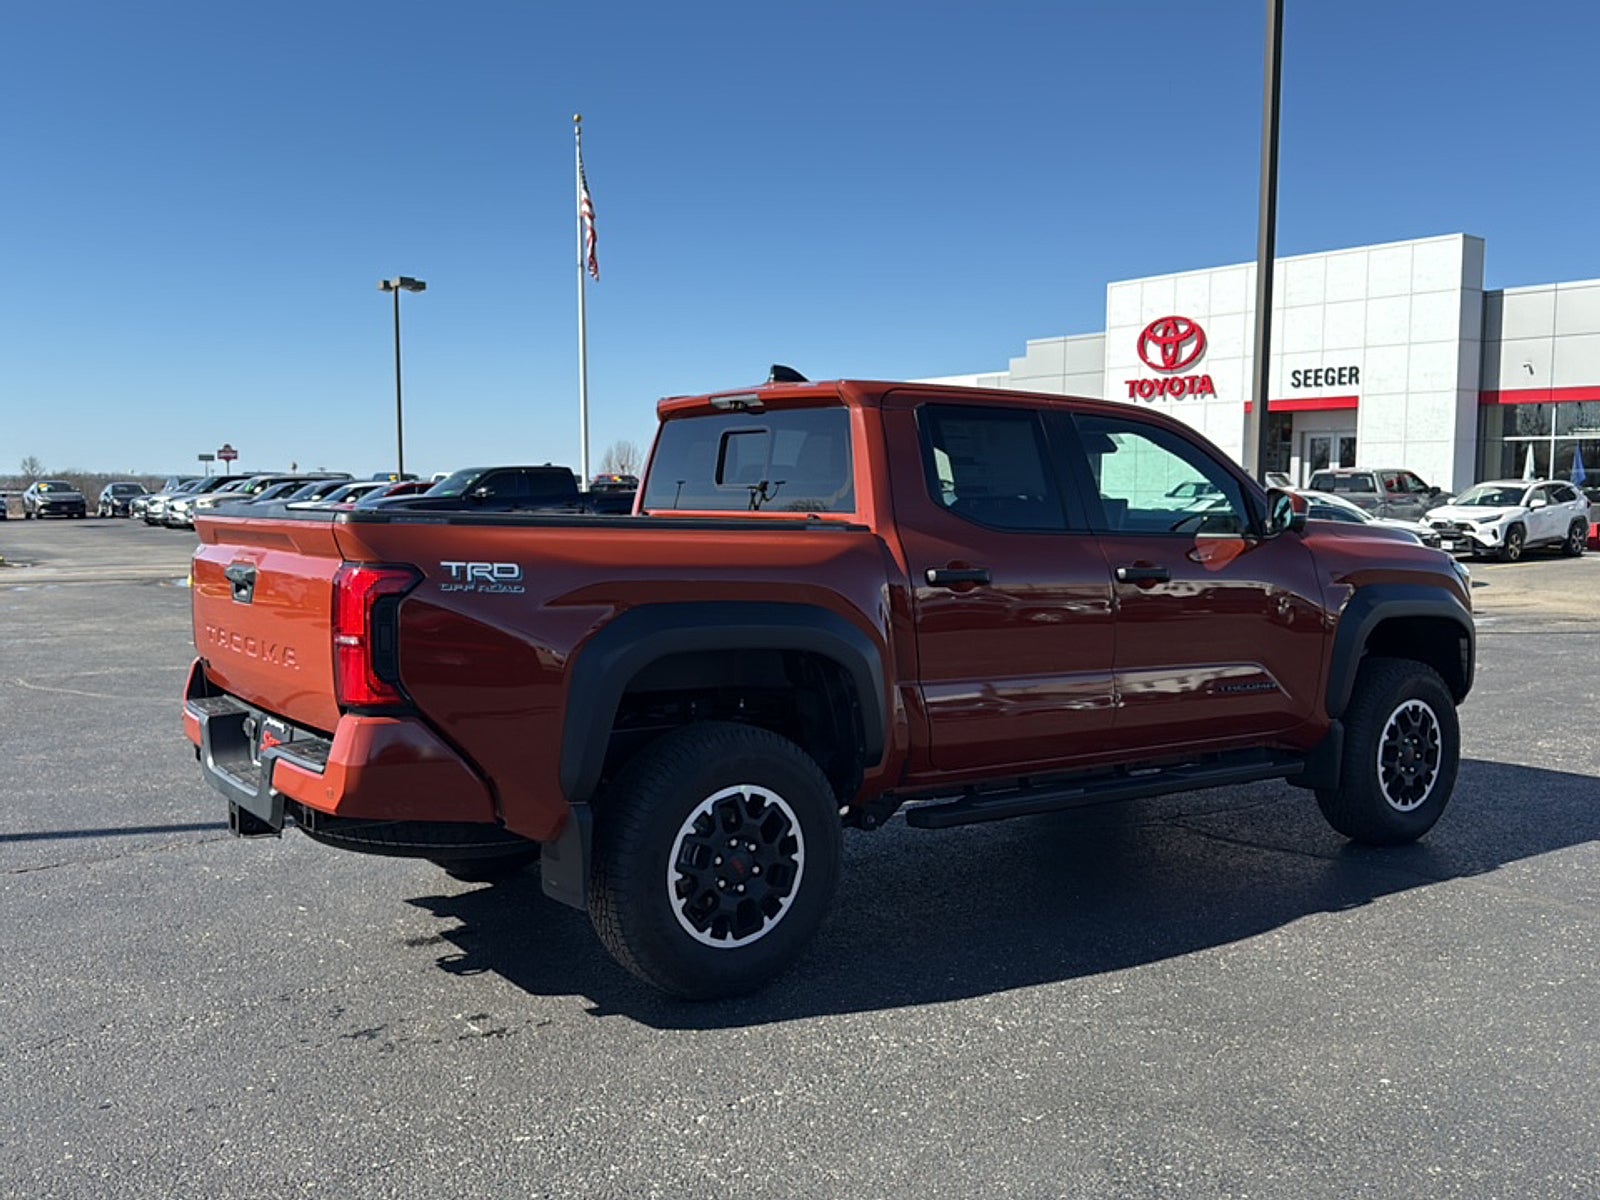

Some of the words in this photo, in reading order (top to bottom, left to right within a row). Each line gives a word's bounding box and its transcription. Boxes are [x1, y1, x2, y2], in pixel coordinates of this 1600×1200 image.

[1124, 374, 1216, 401] TOYOTA
[1291, 366, 1360, 388] SEEGER
[440, 561, 520, 582] TRD
[205, 624, 300, 671] TACOMA
